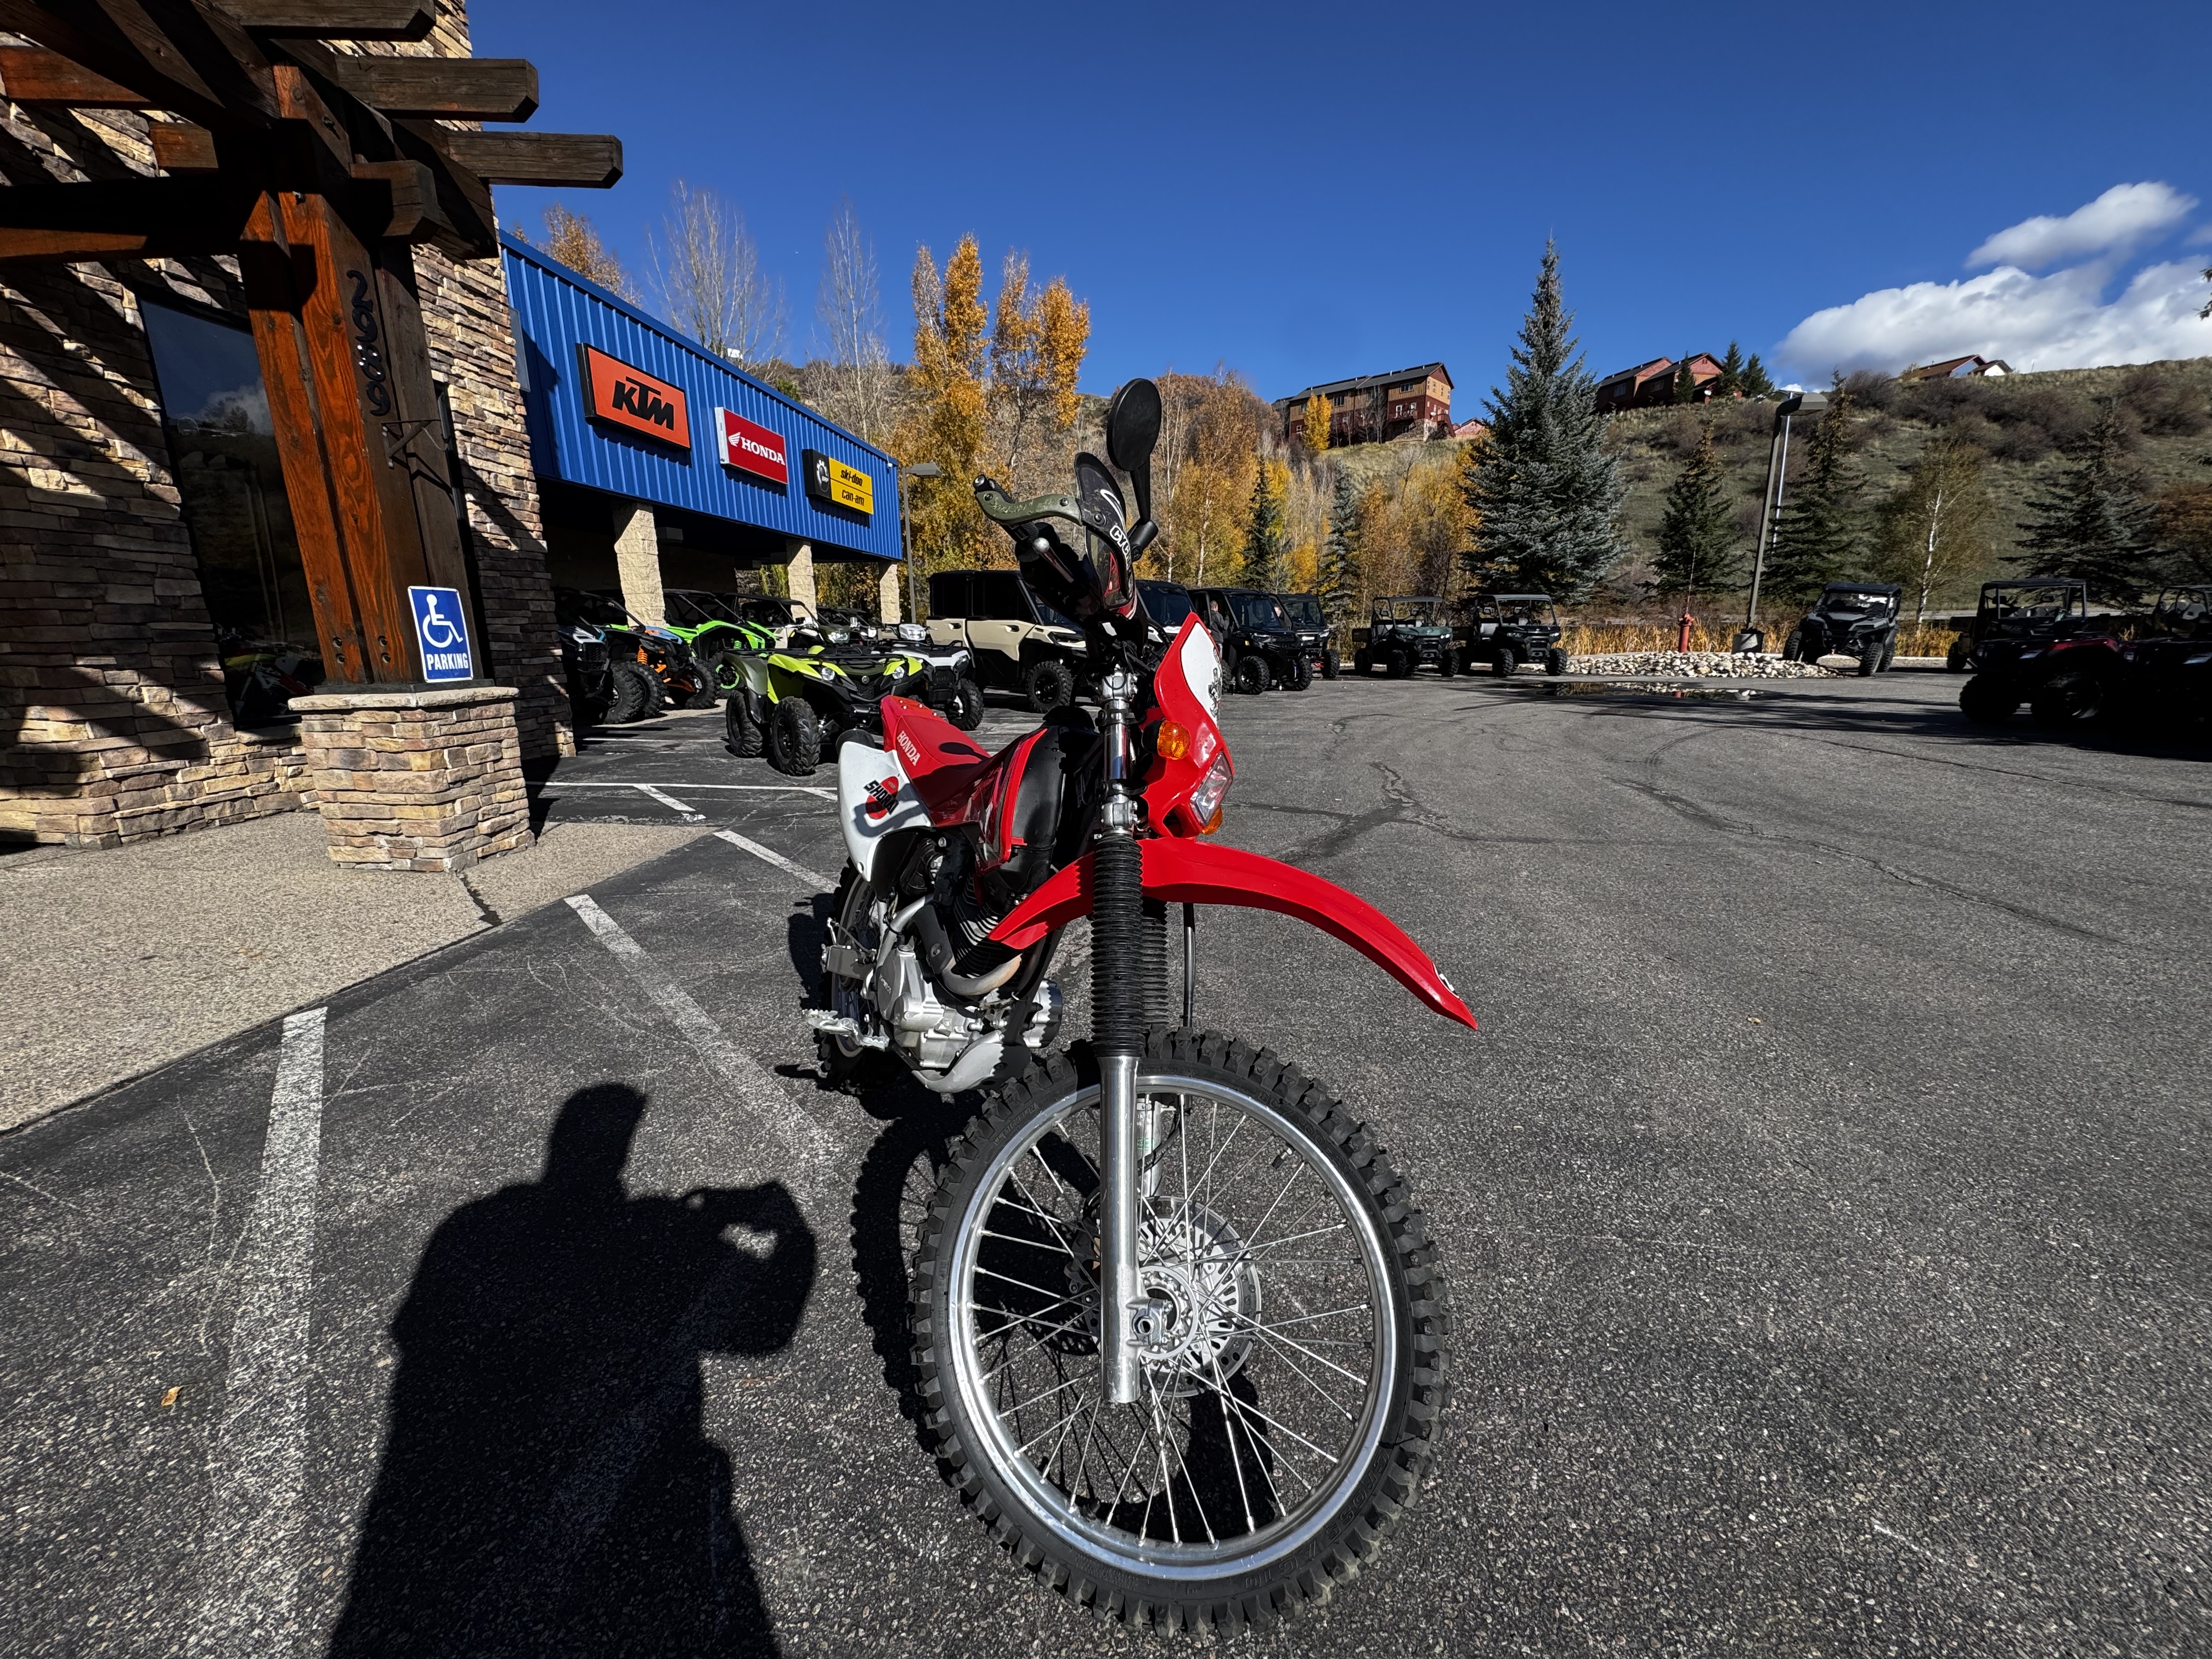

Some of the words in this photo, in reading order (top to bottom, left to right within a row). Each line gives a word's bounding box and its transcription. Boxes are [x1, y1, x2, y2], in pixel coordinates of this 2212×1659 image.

[347, 270, 391, 416] 2989
[612, 376, 674, 431] KTM
[741, 437, 785, 465] HONDA
[840, 469, 863, 487] ski-doo
[842, 489, 865, 506] can-am
[426, 653, 469, 670] PARKING
[896, 730, 921, 766] HONDA
[864, 780, 899, 815] SHORAI
